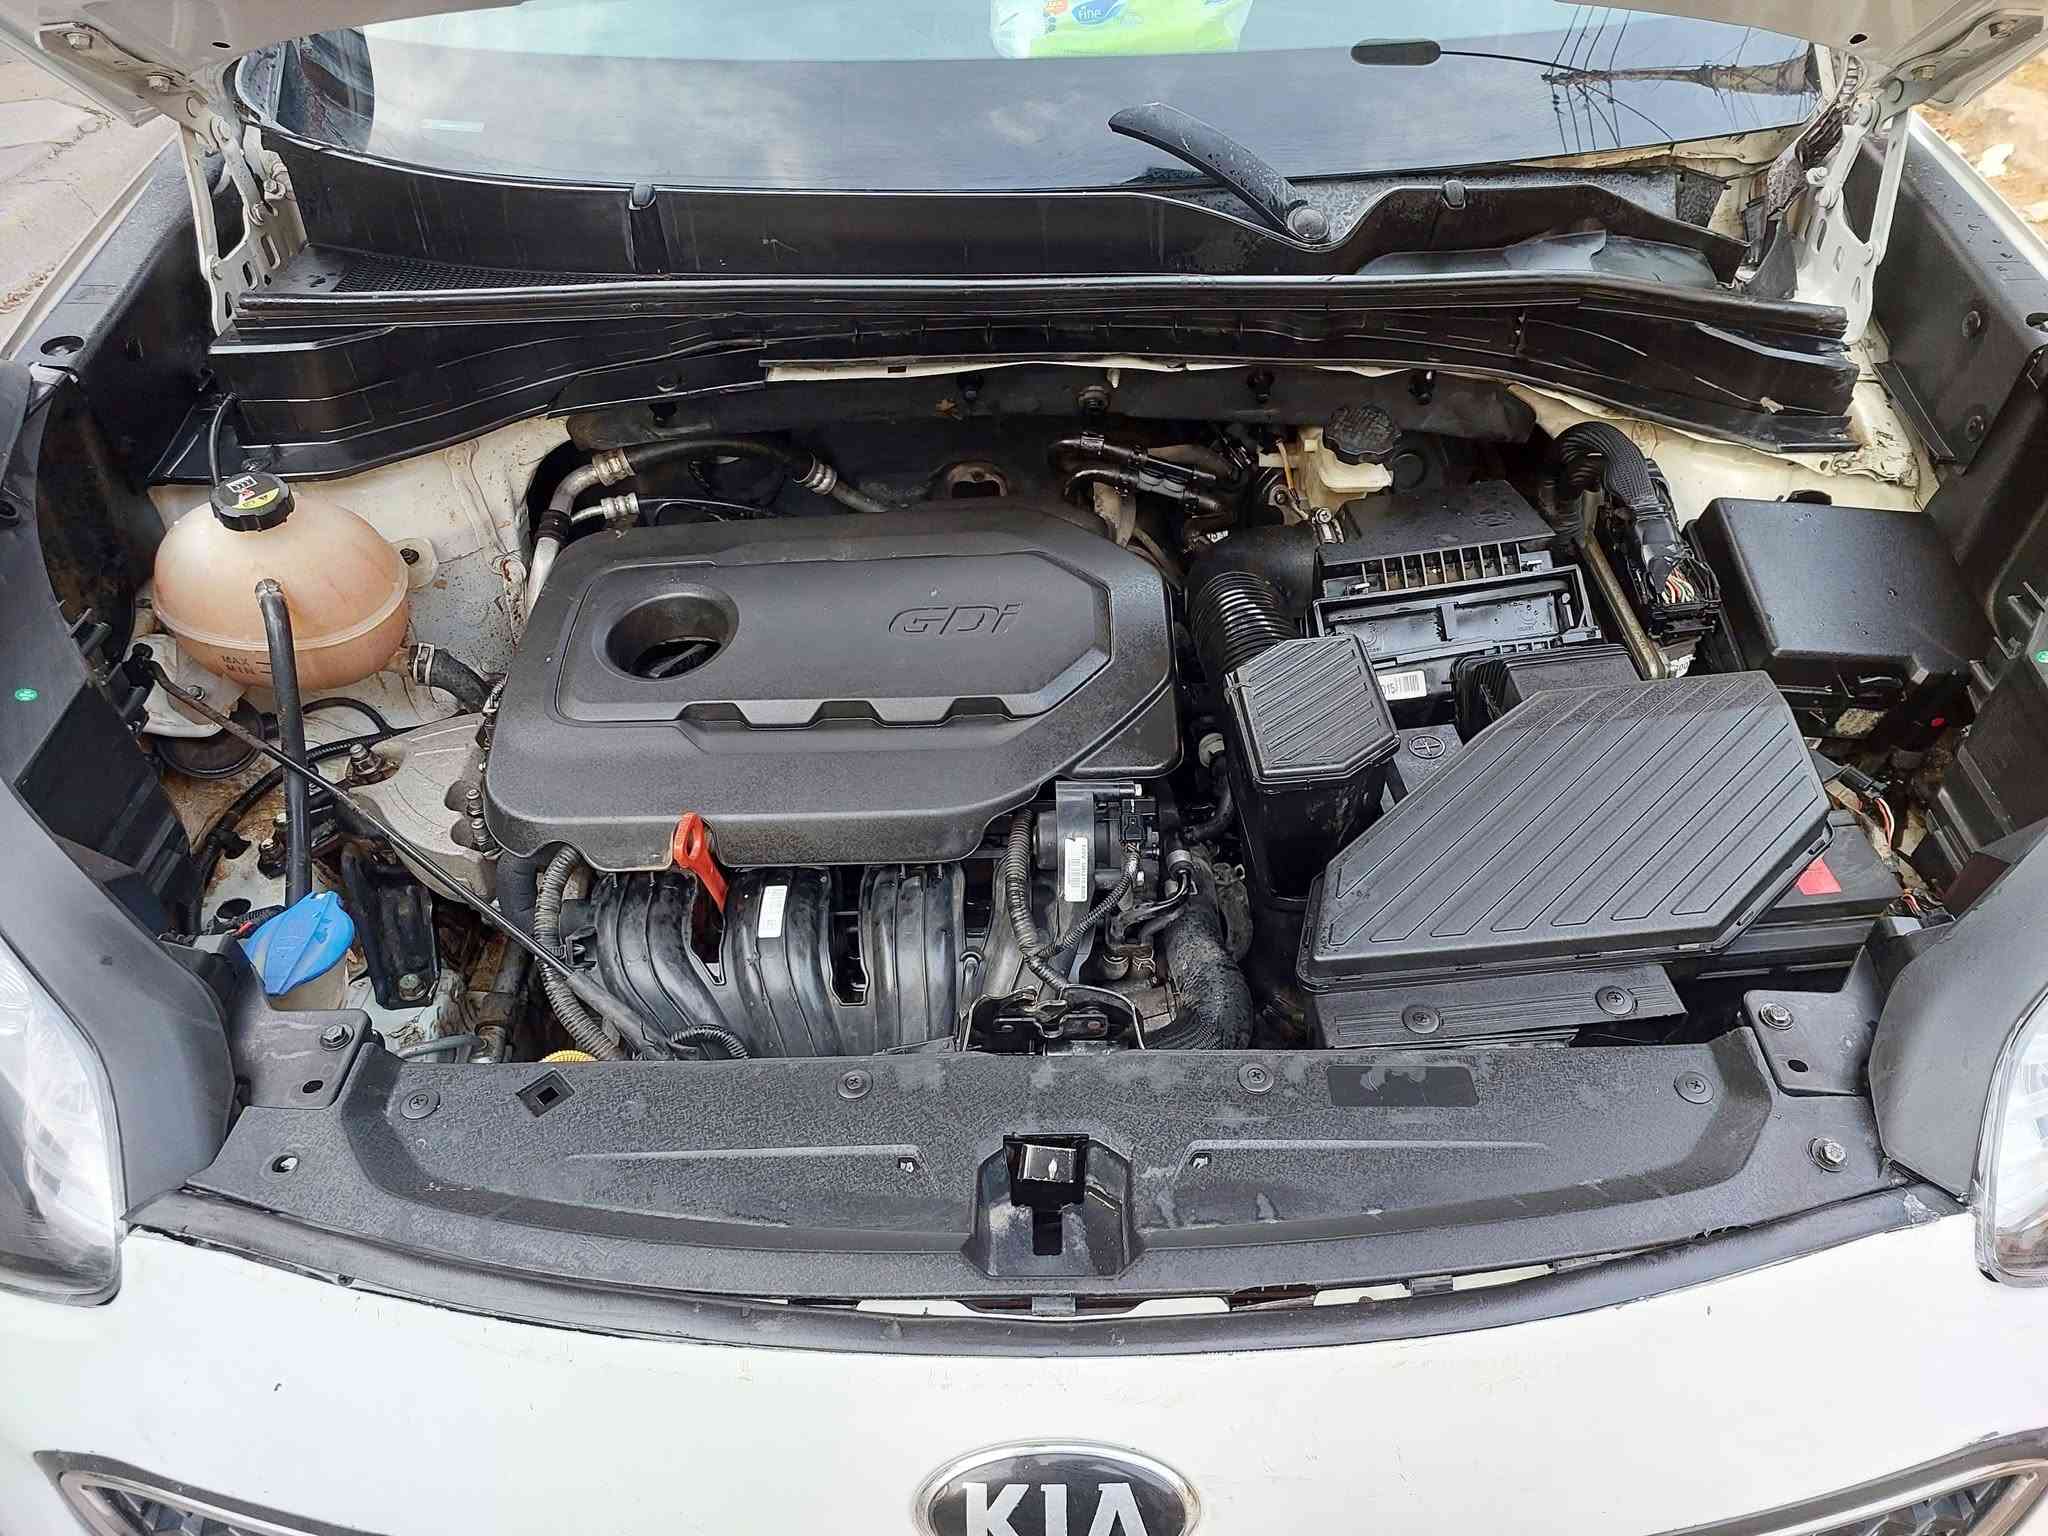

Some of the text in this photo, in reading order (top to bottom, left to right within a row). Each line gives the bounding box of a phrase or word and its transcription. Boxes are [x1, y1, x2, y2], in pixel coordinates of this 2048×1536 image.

[1078, 5, 1102, 19] fine
[221, 655, 250, 666] MAX
[225, 664, 256, 675] MIN
[962, 1482, 1150, 1536] KIA
